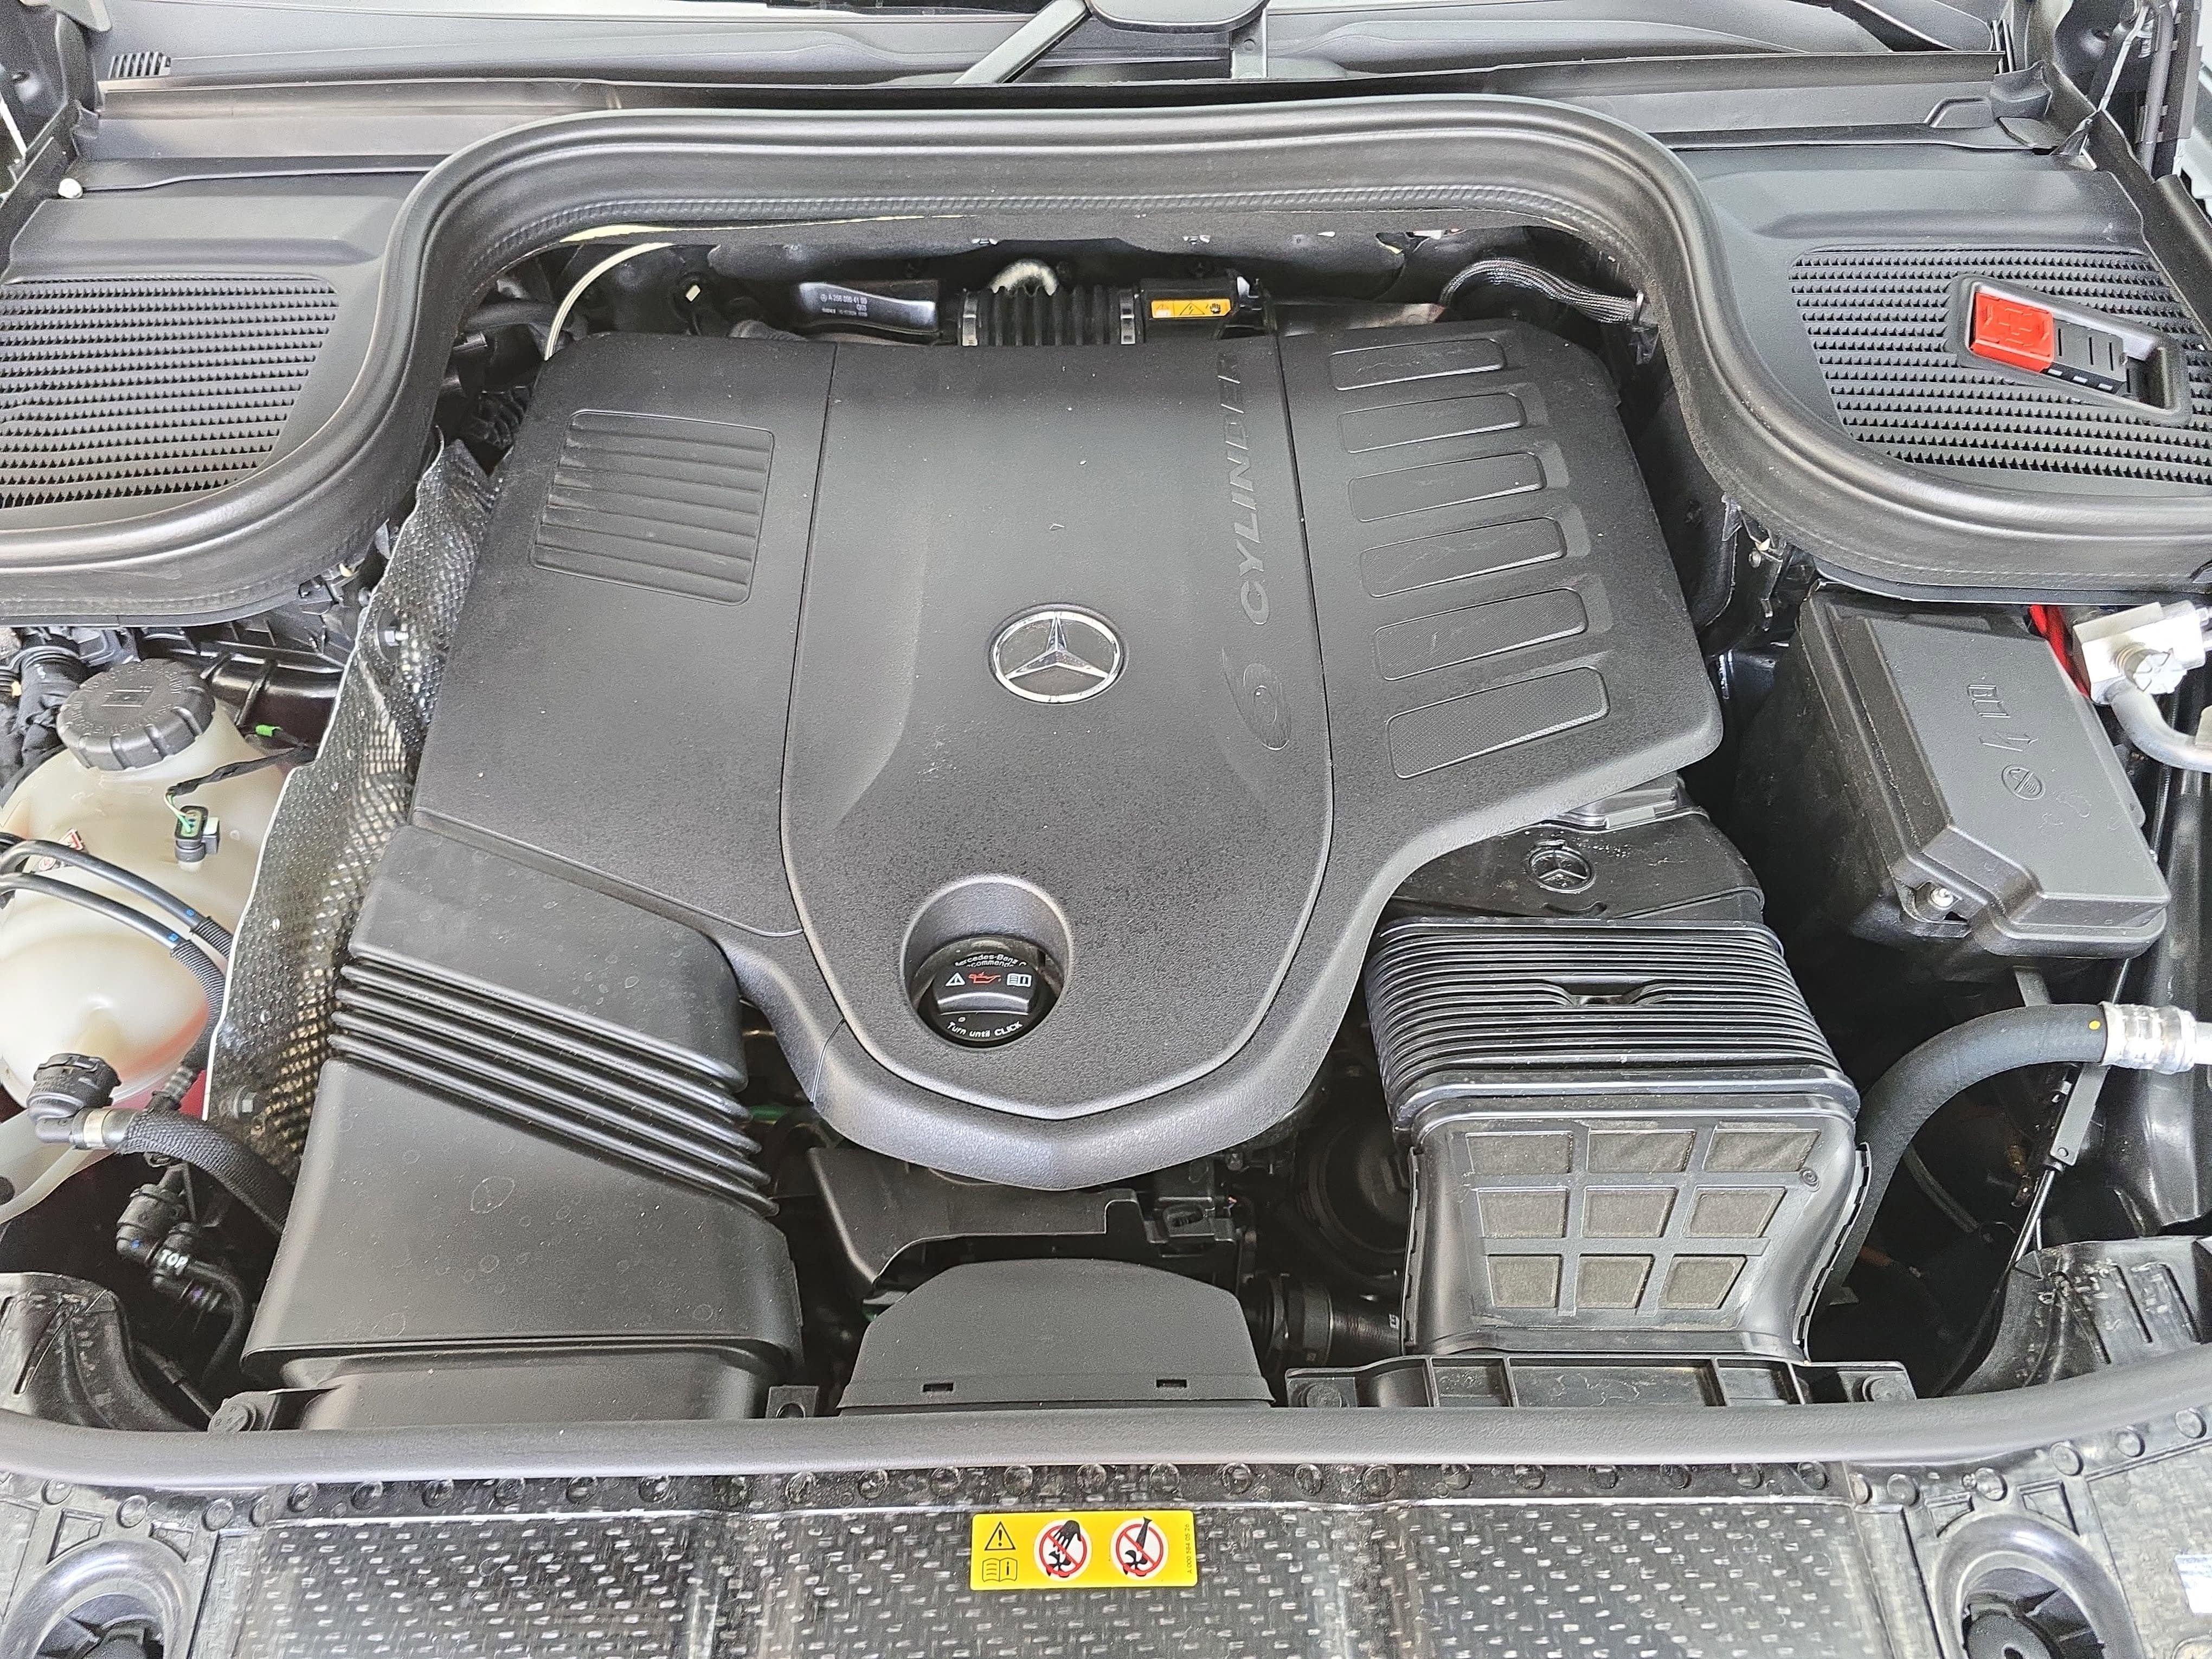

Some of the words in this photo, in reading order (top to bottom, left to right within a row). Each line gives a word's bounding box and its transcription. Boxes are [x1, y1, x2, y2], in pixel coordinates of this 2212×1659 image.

[947, 1021, 967, 1036] Turn
[969, 1030, 991, 1038] until
[994, 1021, 1023, 1036] CLICK
[159, 1249, 189, 1268] TOP
